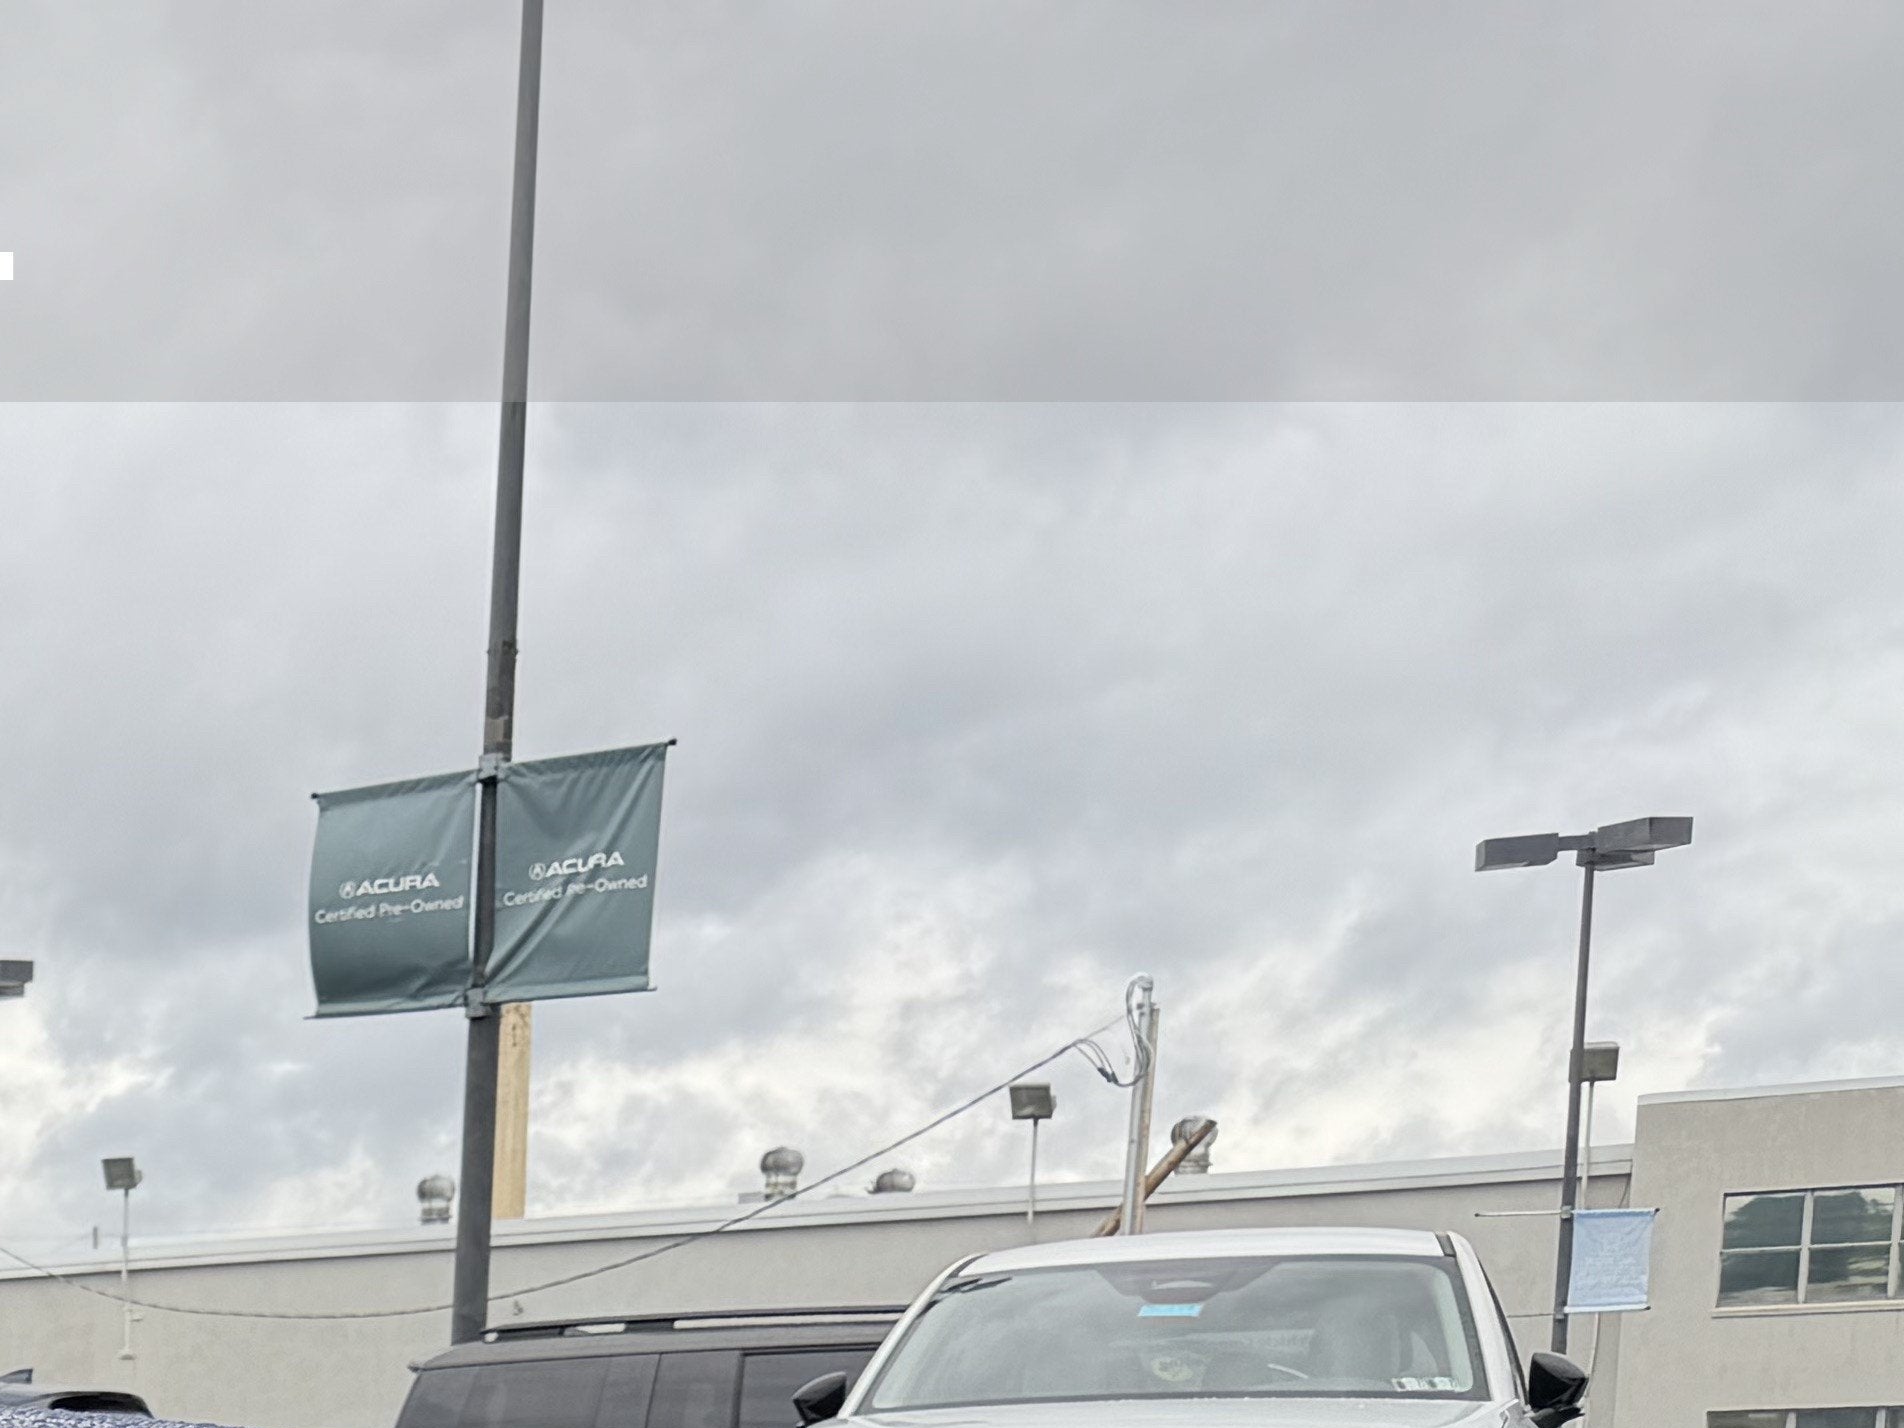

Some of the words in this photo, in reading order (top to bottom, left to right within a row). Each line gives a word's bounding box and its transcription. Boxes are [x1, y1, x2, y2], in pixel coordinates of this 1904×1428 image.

[545, 851, 625, 878] ACURA
[356, 872, 440, 896] ACURA
[503, 885, 563, 906] Certified
[314, 904, 376, 924] Certified
[379, 895, 465, 918] Pre-Owned
